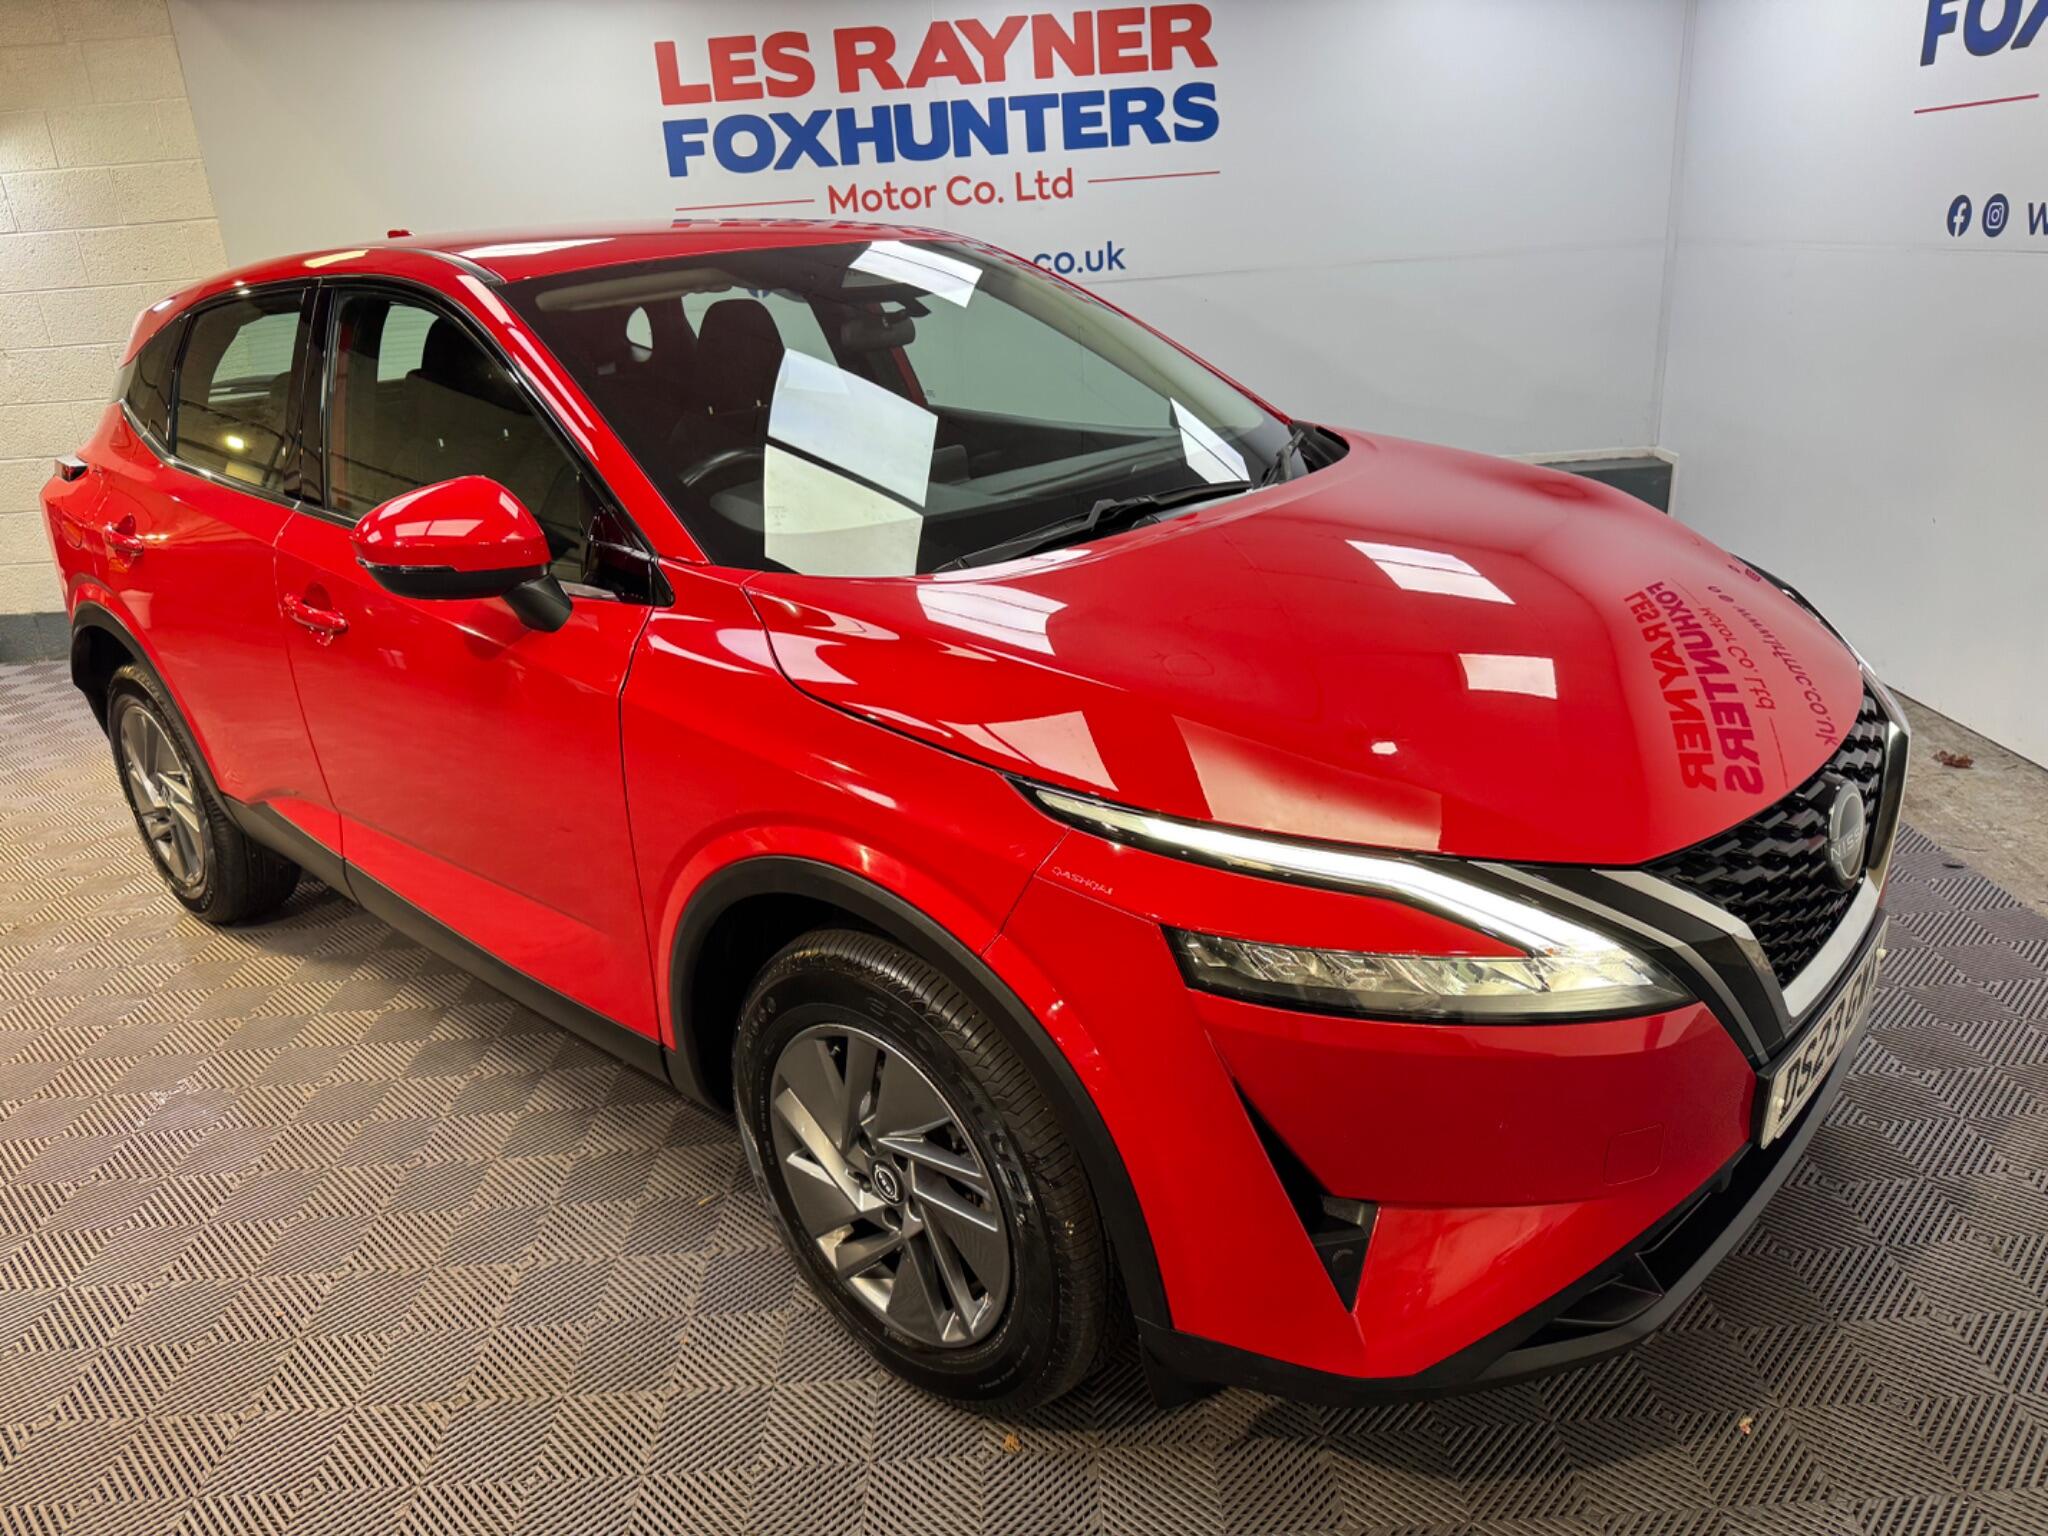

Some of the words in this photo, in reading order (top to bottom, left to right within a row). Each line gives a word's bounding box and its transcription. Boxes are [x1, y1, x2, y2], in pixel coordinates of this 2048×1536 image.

[654, 31, 815, 105] LES
[833, 4, 1218, 93] RAYNER
[662, 82, 1220, 177] FOXHUNTERS
[827, 181, 938, 214] Motor
[946, 175, 1004, 206] Co.
[1015, 168, 1073, 201] Ltd
[1778, 996, 1846, 1122] DS23
